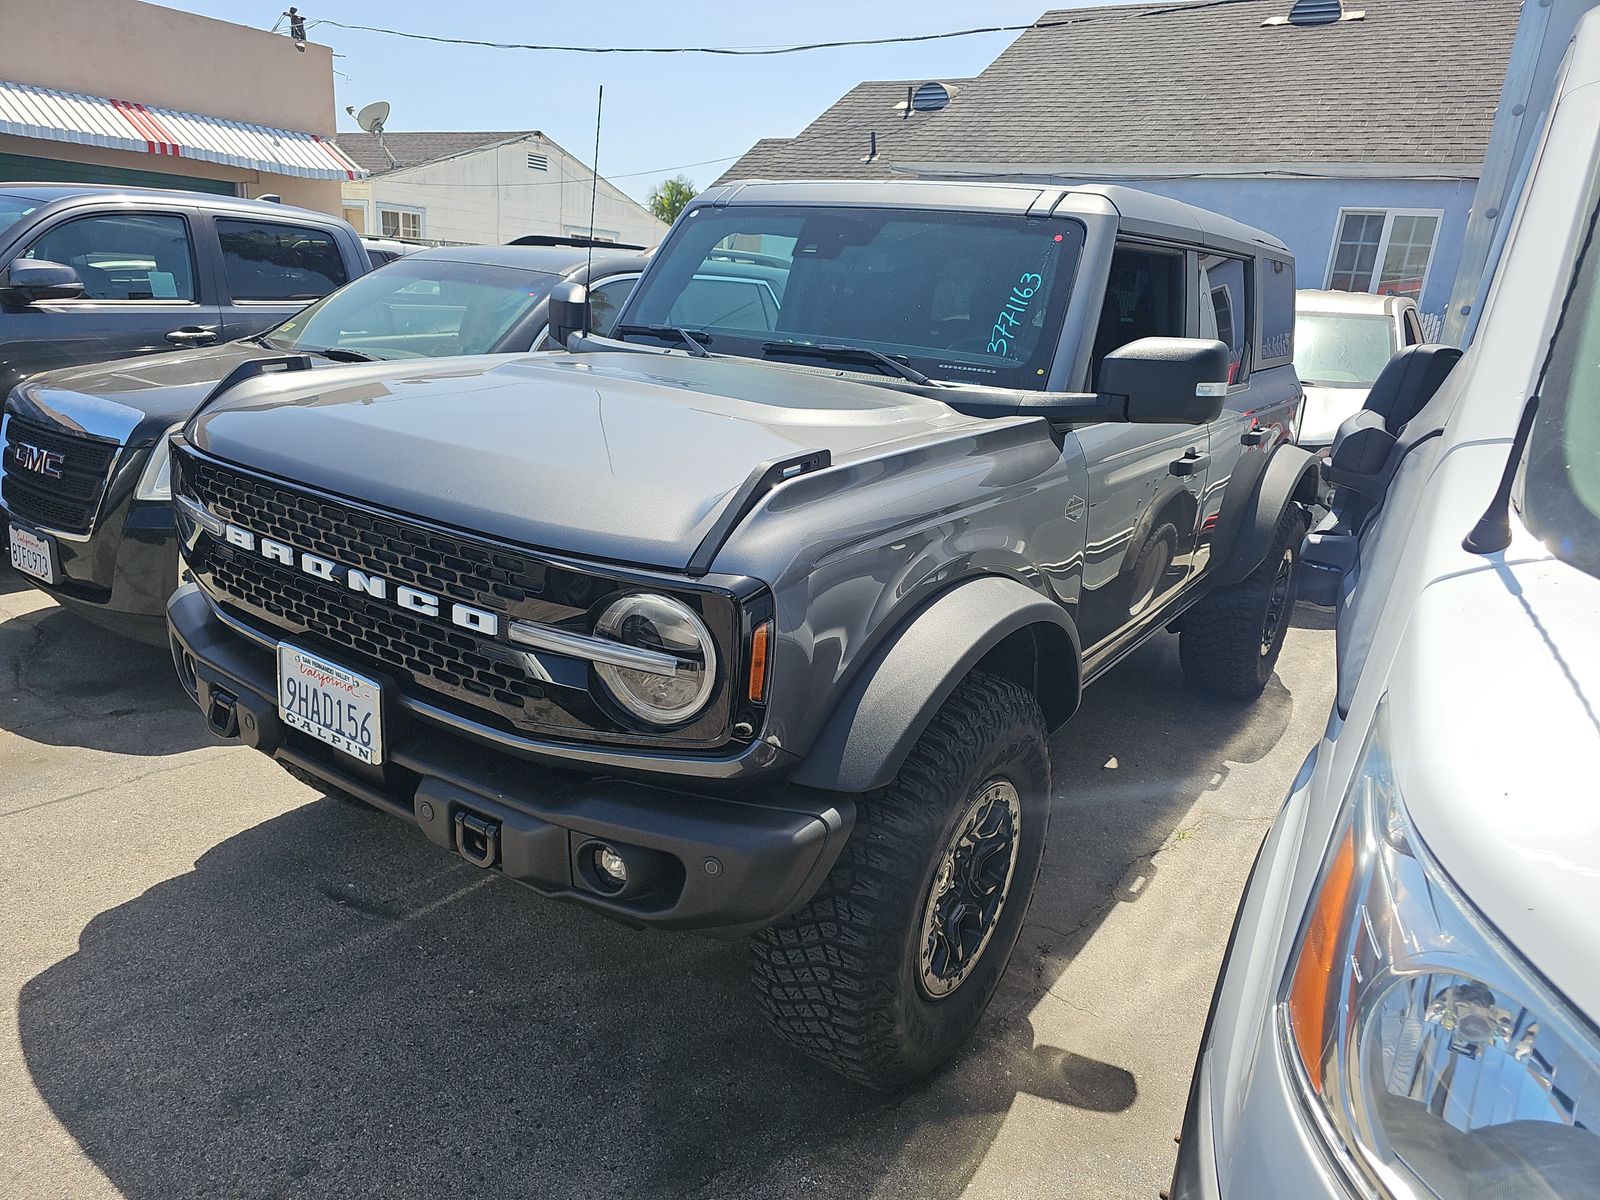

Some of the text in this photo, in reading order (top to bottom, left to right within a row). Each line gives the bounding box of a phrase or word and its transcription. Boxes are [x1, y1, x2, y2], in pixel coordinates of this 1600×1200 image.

[987, 273, 1042, 356] 3771163
[14, 442, 65, 479] GMC
[226, 524, 499, 636] BRONCO
[299, 664, 360, 697] California
[301, 656, 350, 682] SAN FERNANDO VALLEY
[286, 677, 372, 748] 9HAD156
